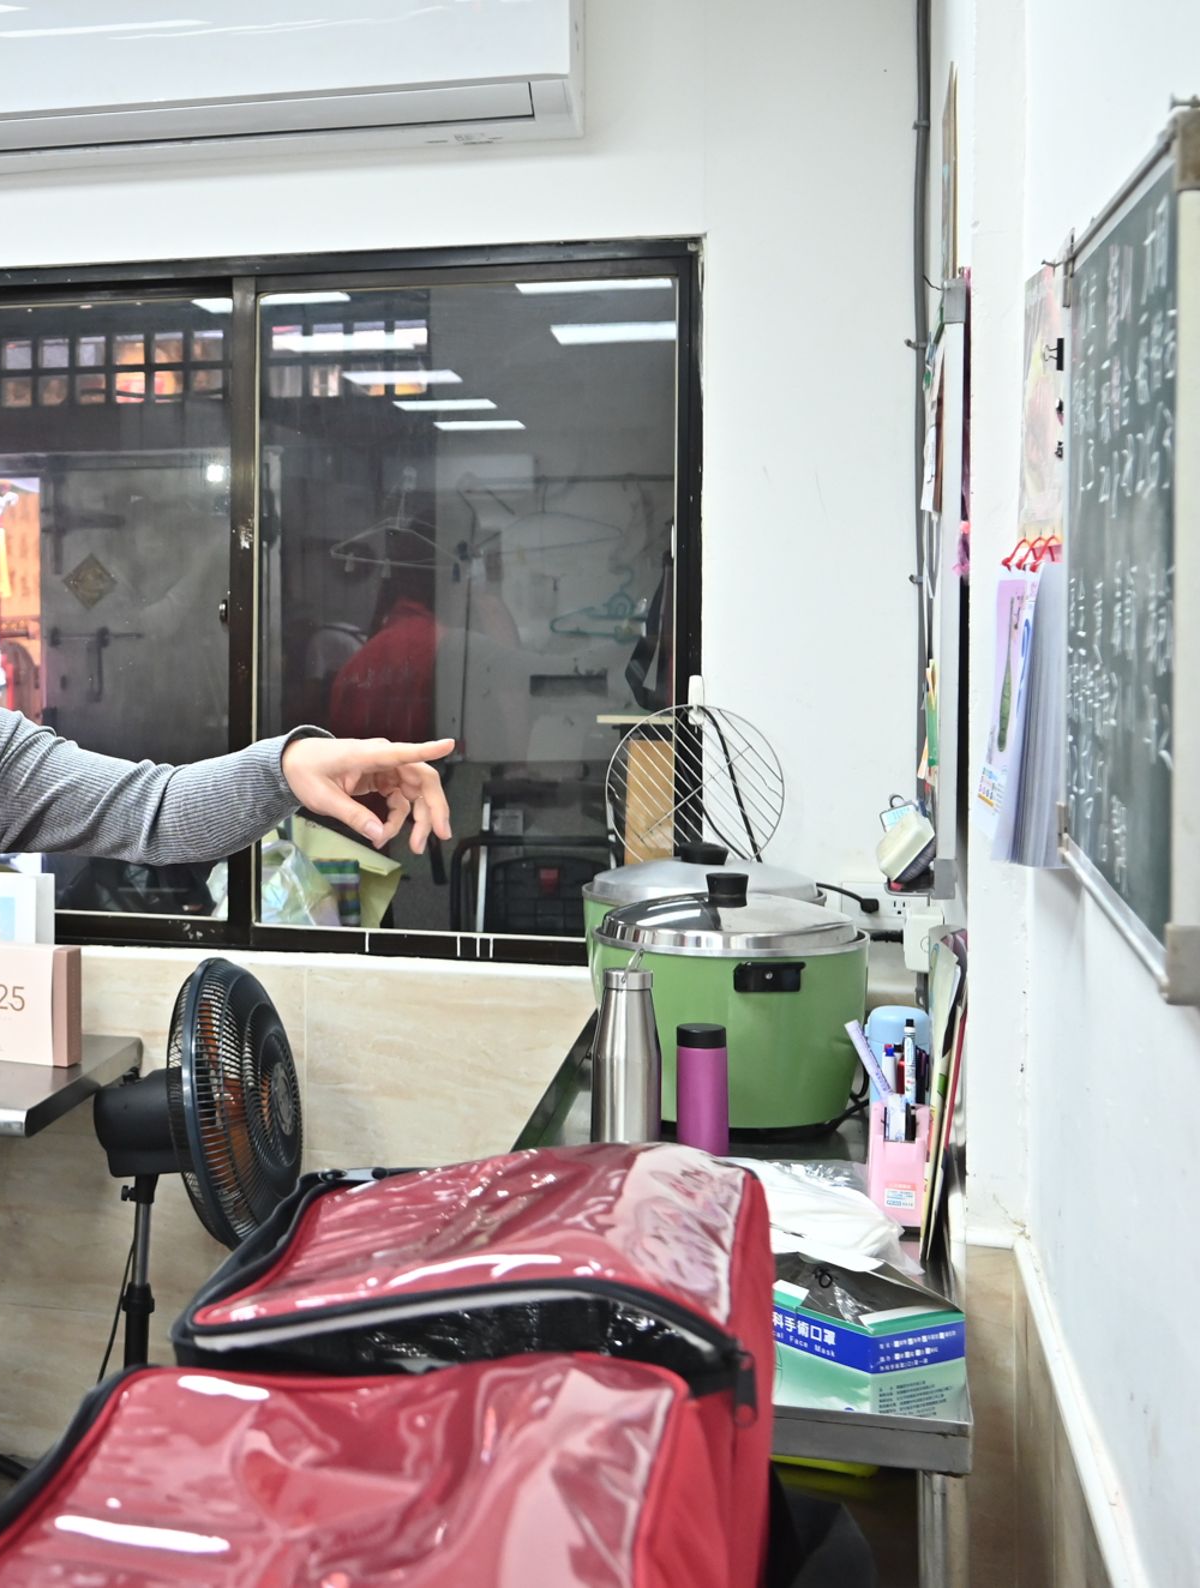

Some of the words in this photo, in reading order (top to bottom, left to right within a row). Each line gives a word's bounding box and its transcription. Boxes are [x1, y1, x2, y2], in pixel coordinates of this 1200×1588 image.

[772, 1311, 836, 1345] 科手術口罩
[814, 1344, 836, 1358] Mask
